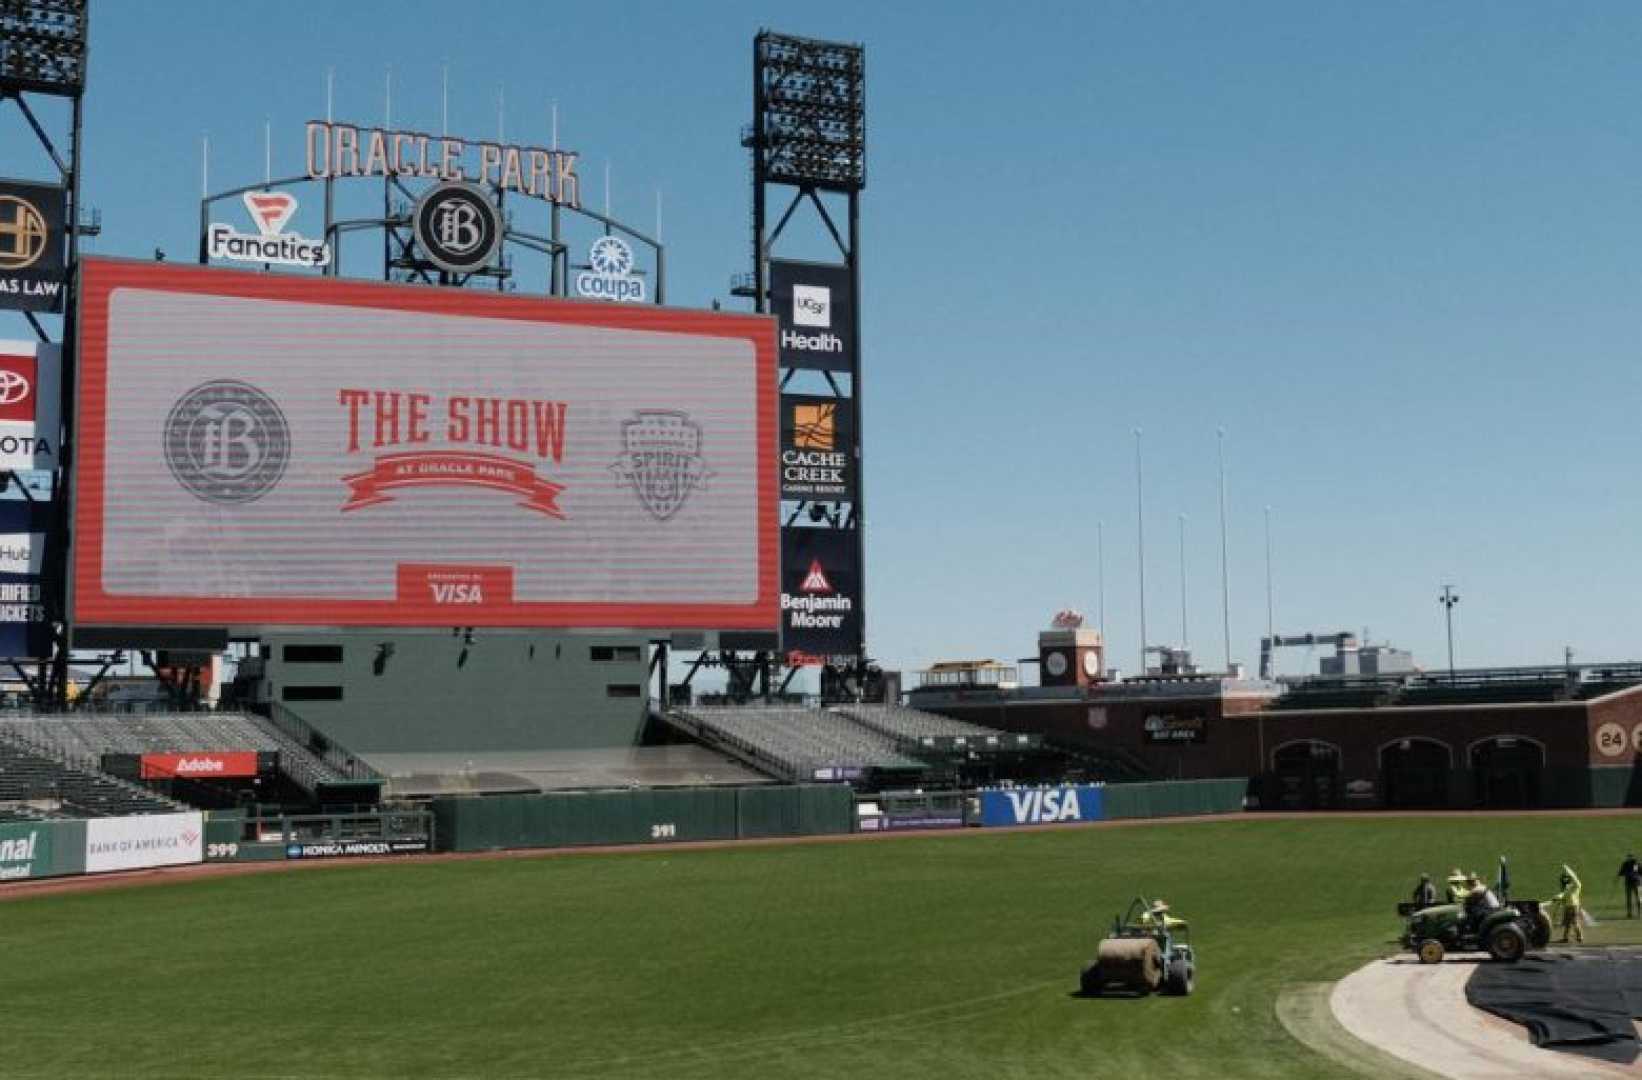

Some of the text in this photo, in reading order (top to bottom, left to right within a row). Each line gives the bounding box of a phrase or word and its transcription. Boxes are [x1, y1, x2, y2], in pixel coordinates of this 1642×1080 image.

[306, 120, 582, 209] ORACLE PARK
[213, 229, 325, 262] Fanatics
[23, 282, 59, 296] LAW
[580, 276, 641, 299] coupa
[782, 330, 843, 352] Health
[340, 389, 432, 453] THE
[448, 397, 567, 465] SHOW
[632, 450, 690, 471] SPIRIT
[782, 450, 847, 467] CACHE
[419, 463, 473, 474] ORACLE
[479, 465, 514, 481] PARK
[784, 467, 844, 483] CREEK
[430, 584, 482, 604] VISA
[781, 593, 851, 613] Benjamin
[791, 611, 844, 628] Moore
[1601, 732, 1622, 748] 24
[176, 758, 224, 772] Adobe
[1004, 789, 1081, 823] VISA
[90, 840, 117, 855] BANK
[135, 837, 178, 850] AMERICA
[207, 844, 239, 857] 399
[302, 844, 392, 857] KONICA MINOLTA
